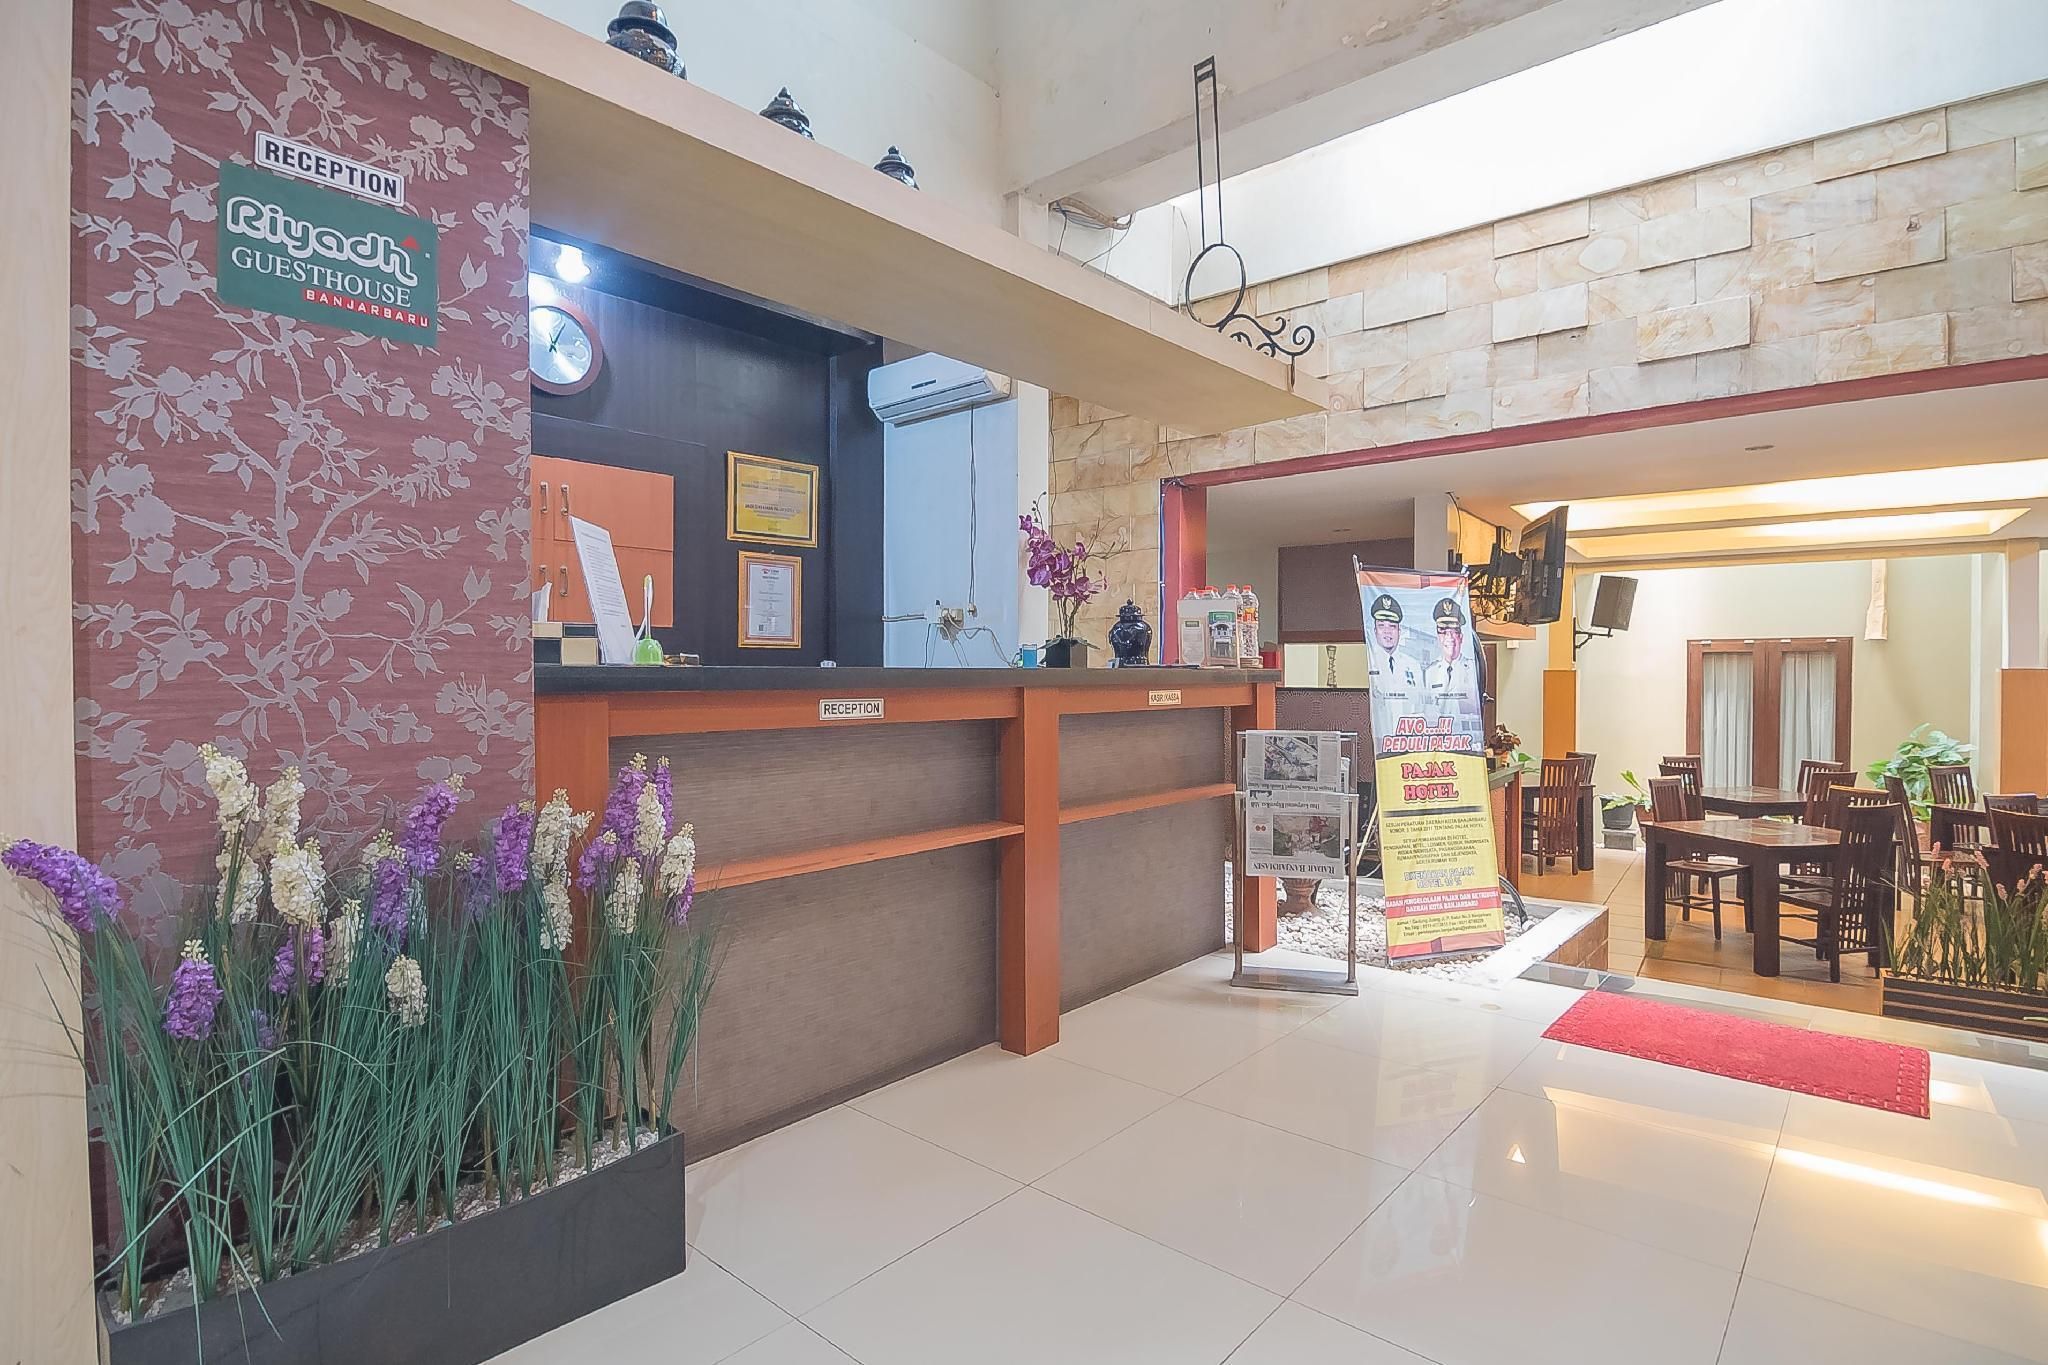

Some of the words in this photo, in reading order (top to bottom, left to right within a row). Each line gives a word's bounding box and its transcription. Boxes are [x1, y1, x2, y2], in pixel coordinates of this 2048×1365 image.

[265, 140, 397, 199] RECEPTION
[227, 196, 417, 286] Riyadh
[232, 246, 411, 307] GUESTHOUSE
[306, 290, 428, 327] BANJARBARU
[824, 703, 880, 715] RECEPTION
[1383, 736, 1428, 752] PEDULI
[1429, 734, 1472, 751] PAJAK
[1401, 761, 1457, 778] PAJAK
[1404, 783, 1458, 801] HOTEL
[1417, 879, 1443, 888] HOTEL
